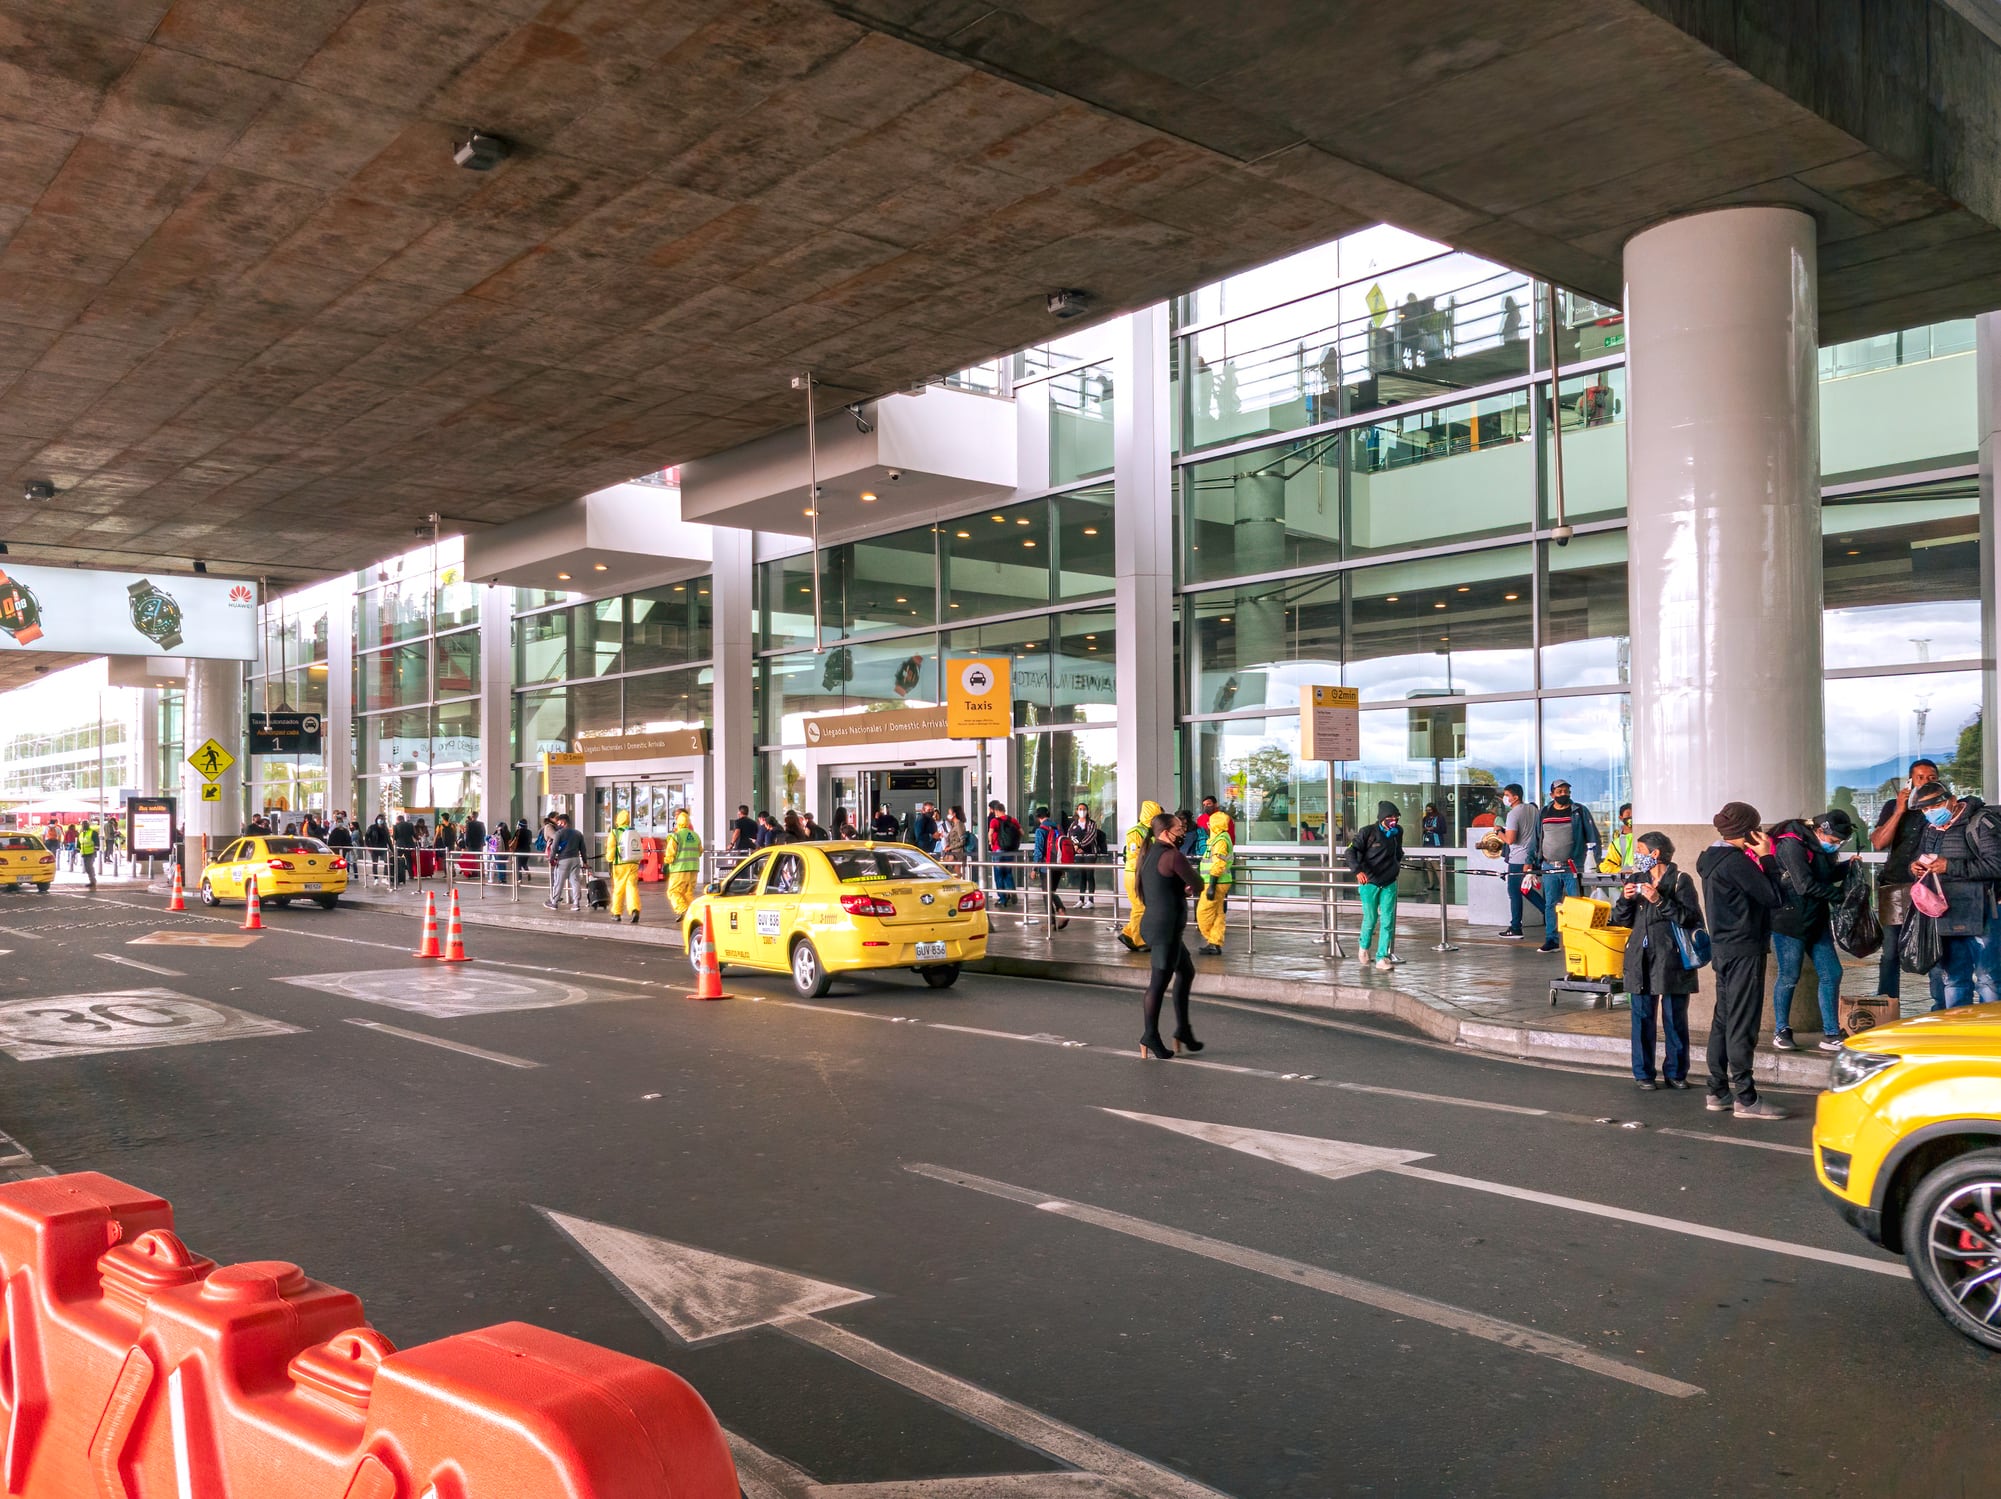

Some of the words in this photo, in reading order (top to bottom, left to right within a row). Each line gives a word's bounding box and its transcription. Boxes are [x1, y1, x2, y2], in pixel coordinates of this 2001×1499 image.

[1338, 690, 1356, 700] 2min
[965, 701, 993, 711] Taxis
[823, 728, 848, 738] Llegadas
[849, 725, 883, 735] Nacionales
[884, 722, 888, 732] /
[890, 720, 920, 731] Domestic
[922, 719, 949, 729] Arrivals
[272, 737, 283, 751] 1
[691, 736, 698, 749] 2
[758, 914, 768, 926] GUV
[770, 914, 780, 927] 836
[916, 946, 930, 957] GUV
[932, 944, 946, 955] 836
[26, 1003, 192, 1032] 30
